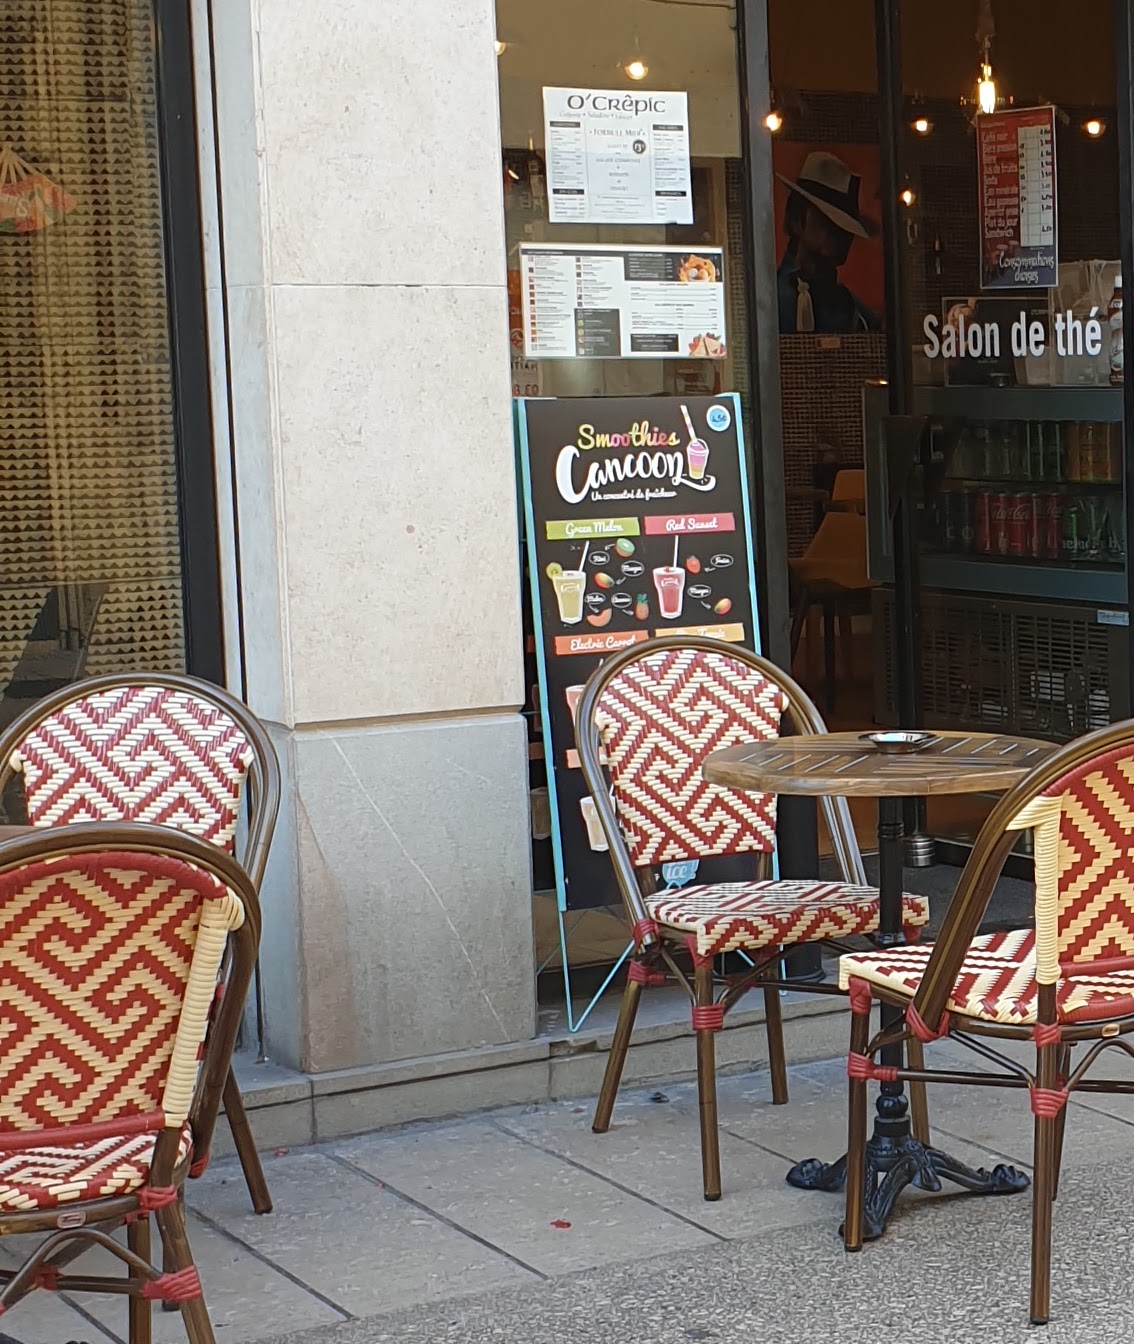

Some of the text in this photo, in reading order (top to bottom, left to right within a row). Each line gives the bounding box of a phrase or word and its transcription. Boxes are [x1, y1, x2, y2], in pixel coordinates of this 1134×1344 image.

[567, 93, 666, 116] O'Crêpic
[923, 306, 1102, 358] Salon de thé
[577, 420, 681, 450] Smoothies
[665, 518, 686, 532] Red
